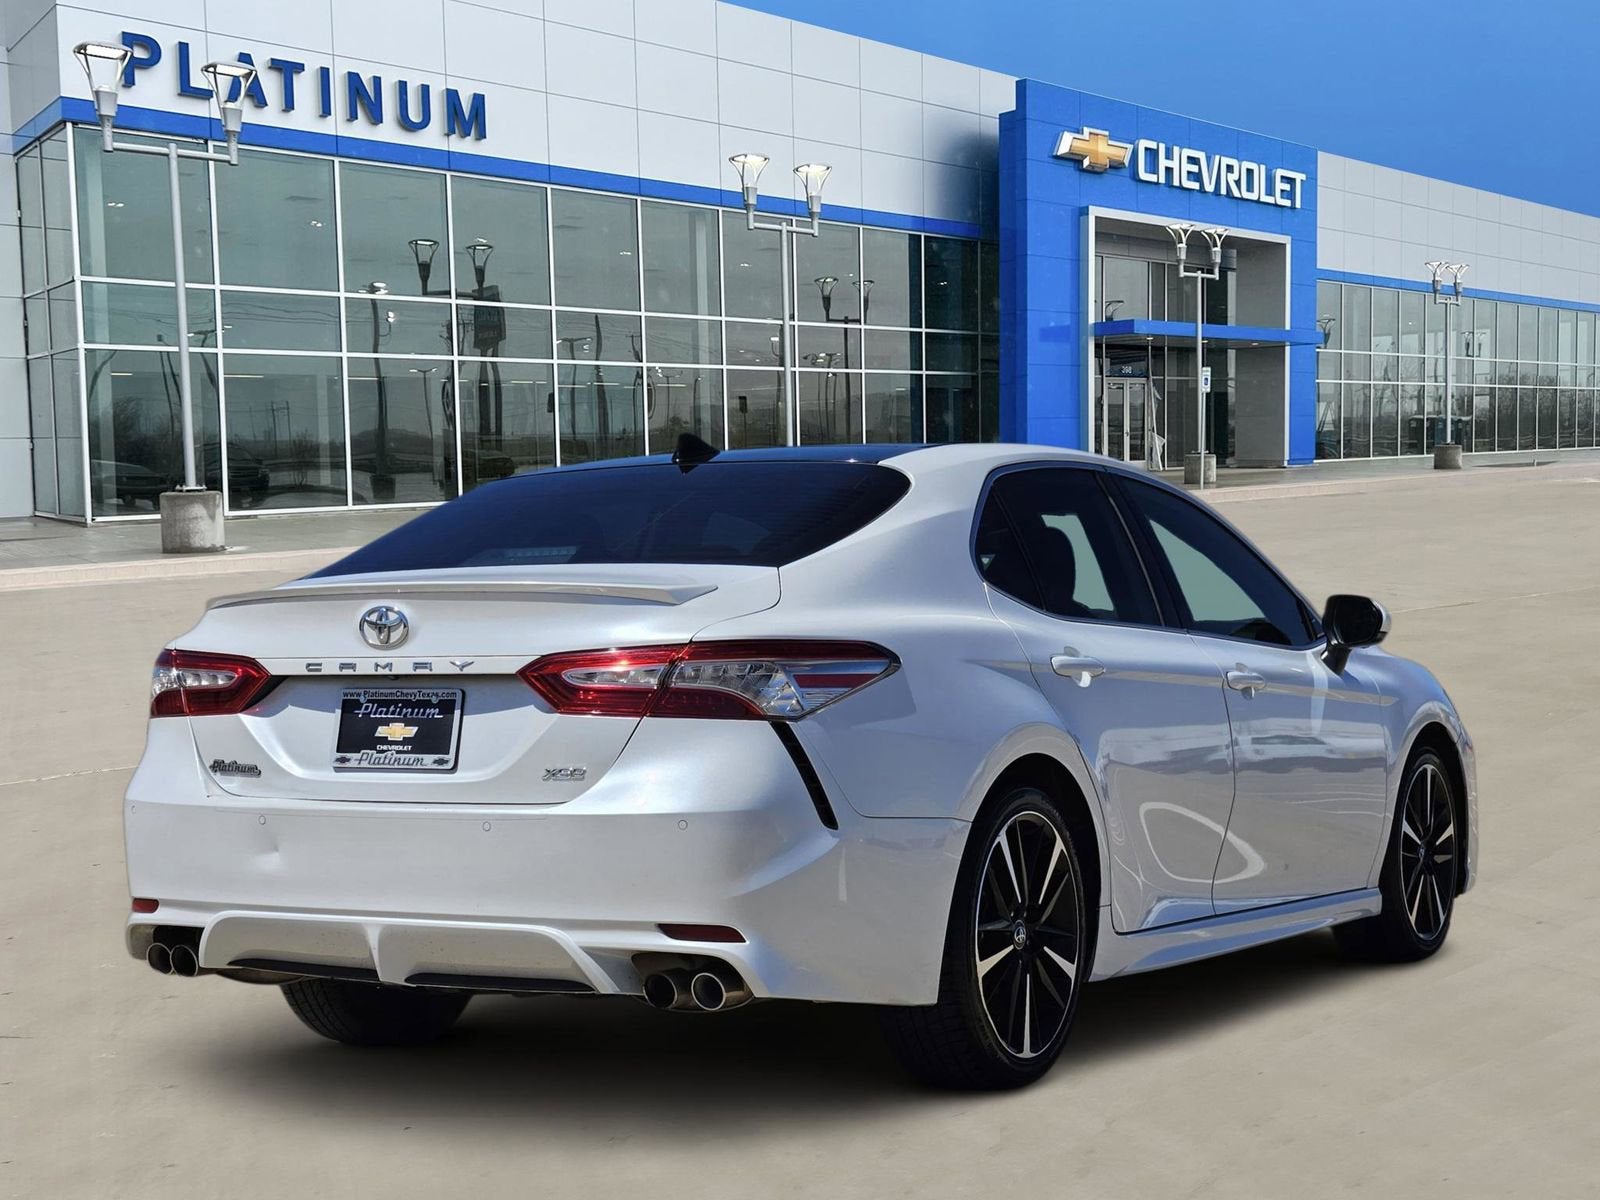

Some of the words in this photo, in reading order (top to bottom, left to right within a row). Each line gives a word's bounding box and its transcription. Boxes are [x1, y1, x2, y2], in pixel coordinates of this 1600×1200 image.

[120, 31, 488, 141] PLATINUM
[1137, 138, 1306, 209] CHEVROLET
[305, 660, 475, 673] CAMRY
[354, 703, 444, 719] Platinum
[354, 751, 428, 767] Platinum
[209, 759, 262, 777] Platinum
